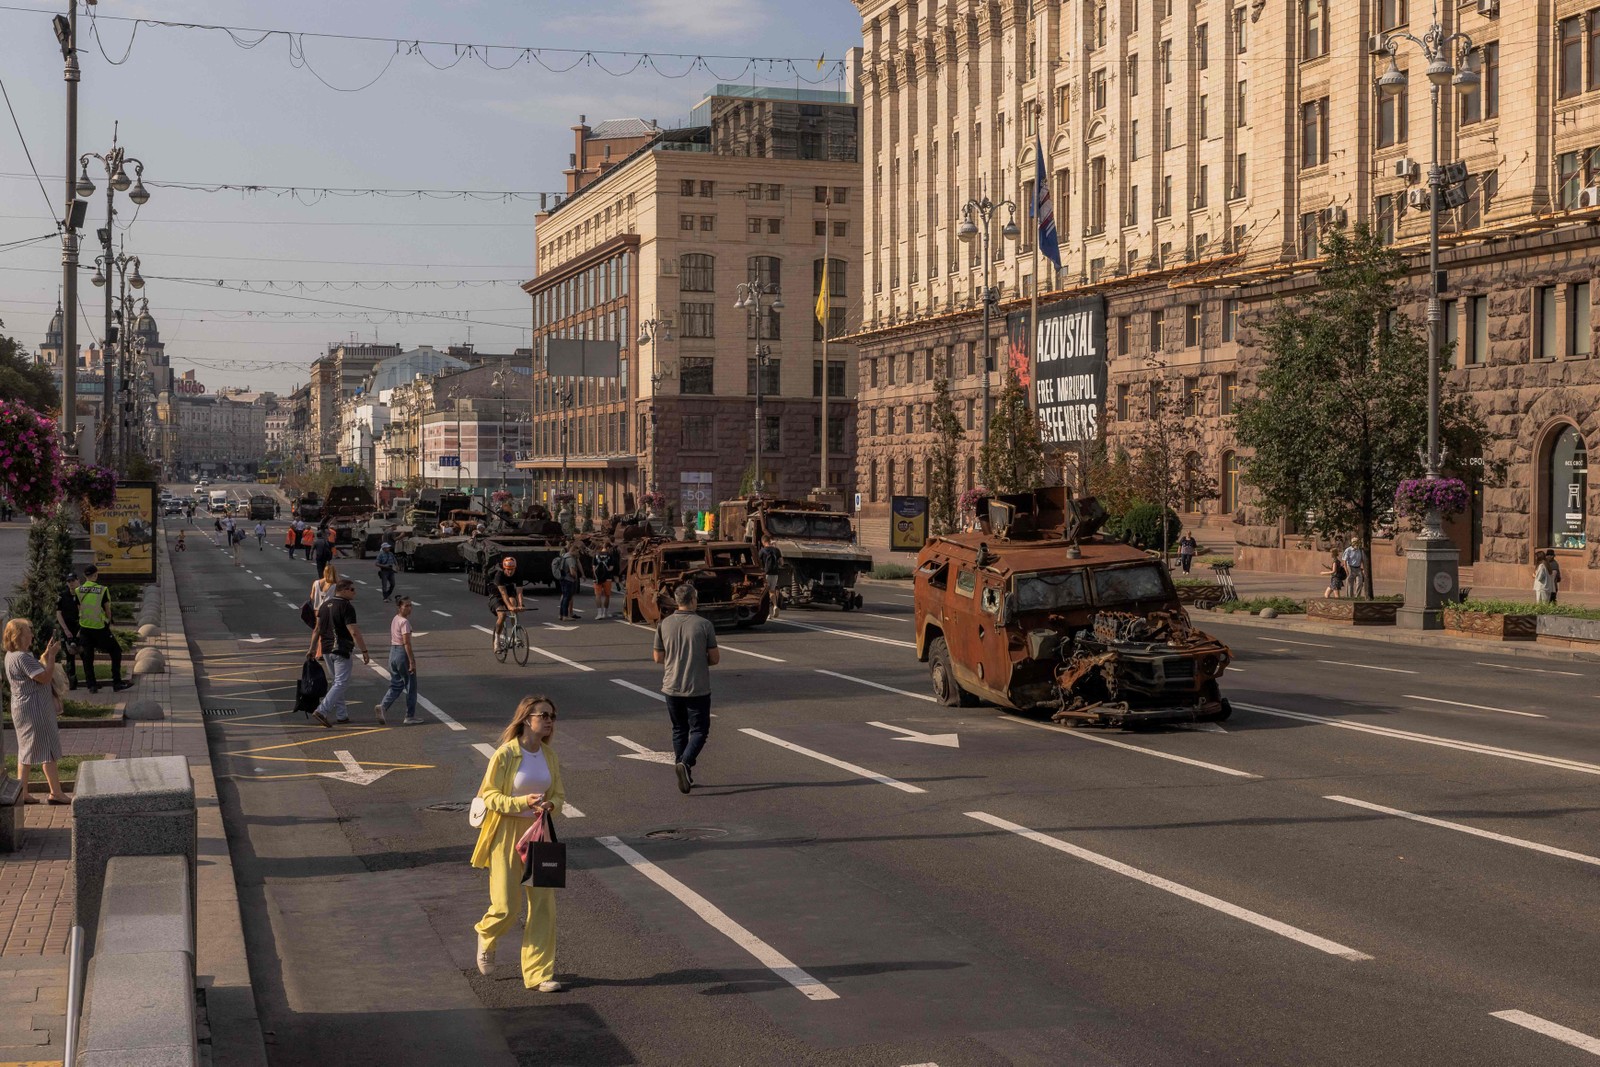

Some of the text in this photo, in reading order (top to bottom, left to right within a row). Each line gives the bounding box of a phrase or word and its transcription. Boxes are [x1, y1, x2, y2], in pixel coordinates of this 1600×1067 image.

[1037, 311, 1096, 362] AZOVSTAL
[177, 382, 205, 393] HUGO
[1037, 379, 1054, 404] FREE
[1039, 403, 1098, 443] DEFENDERS
